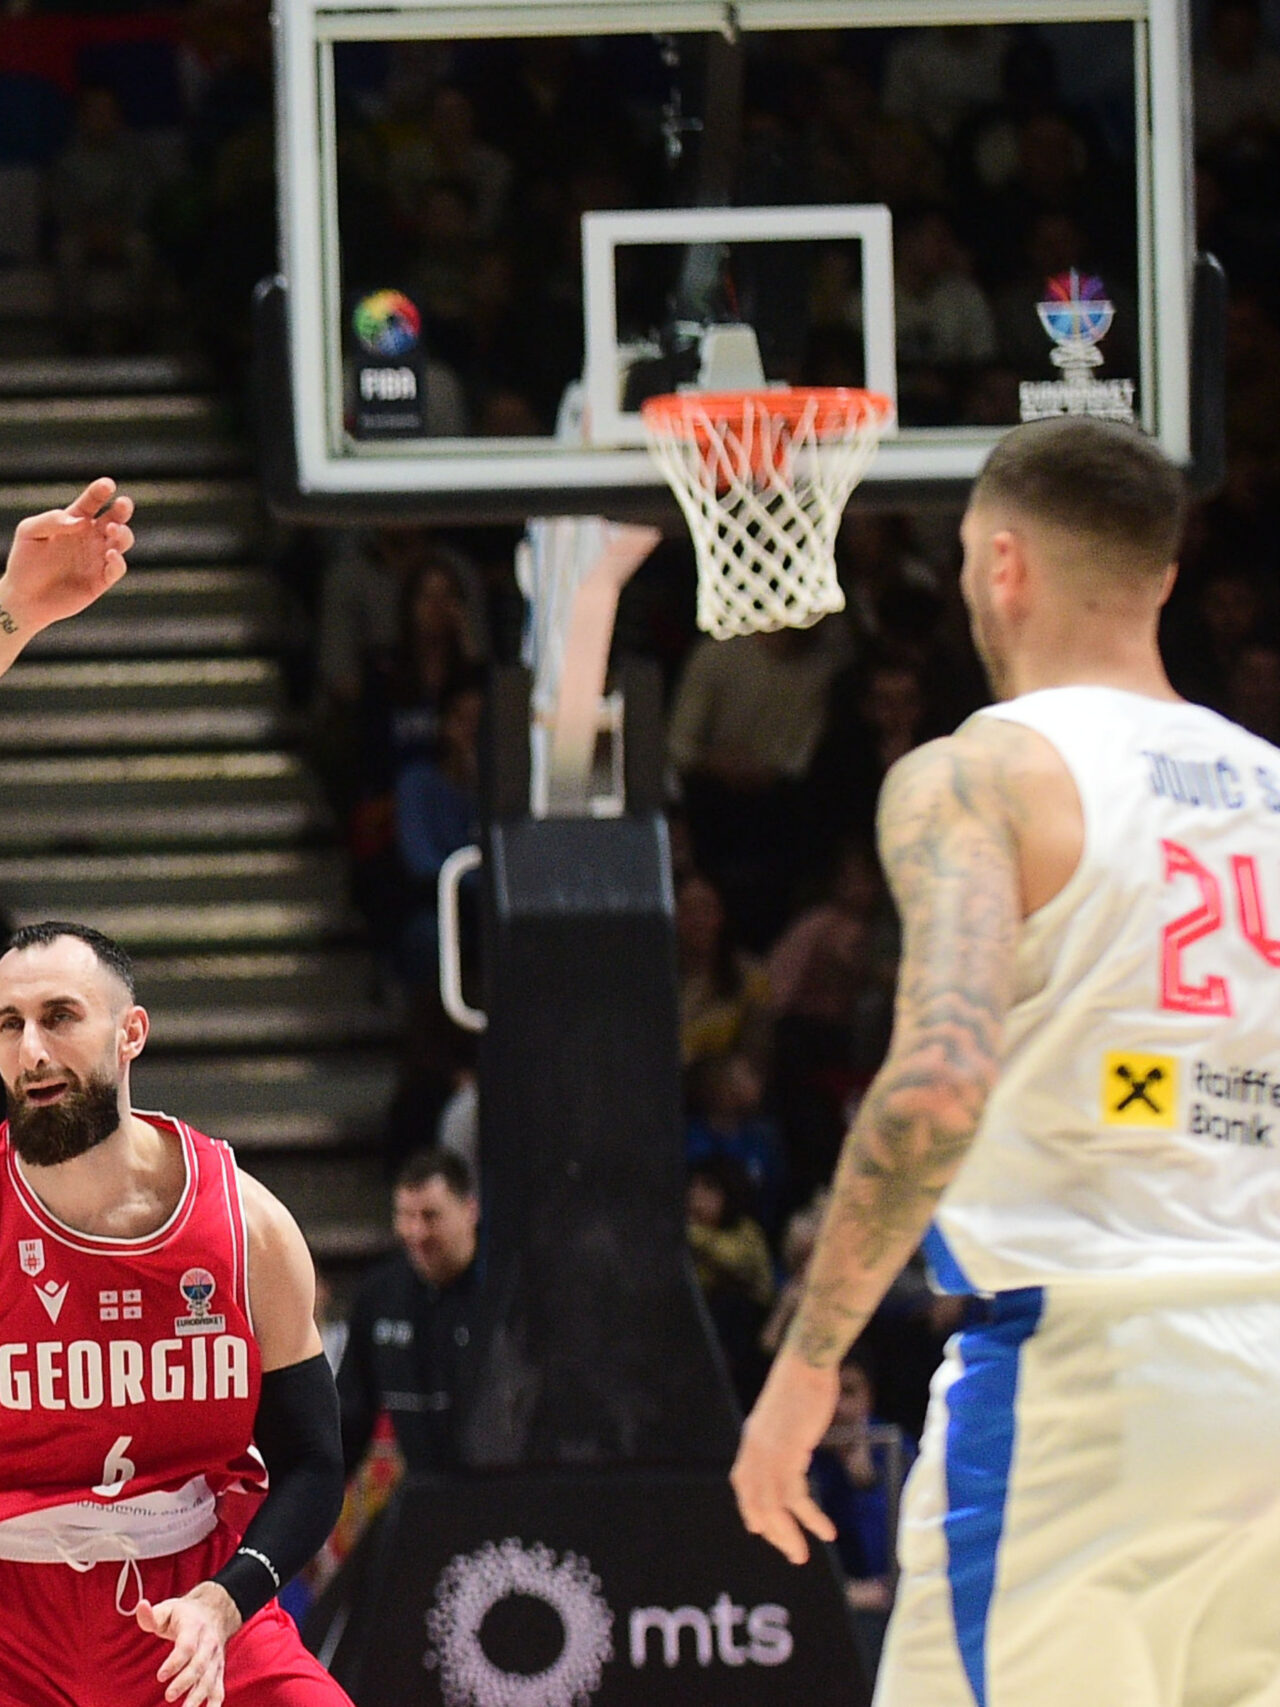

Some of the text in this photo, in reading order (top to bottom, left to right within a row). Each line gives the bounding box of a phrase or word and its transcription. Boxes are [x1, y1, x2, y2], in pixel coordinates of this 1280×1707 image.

[360, 366, 417, 401] FIBA
[1159, 837, 1280, 1017] 24
[1191, 1103, 1274, 1148] Bank
[91, 1435, 136, 1498] 6
[629, 1591, 795, 1668] mts
